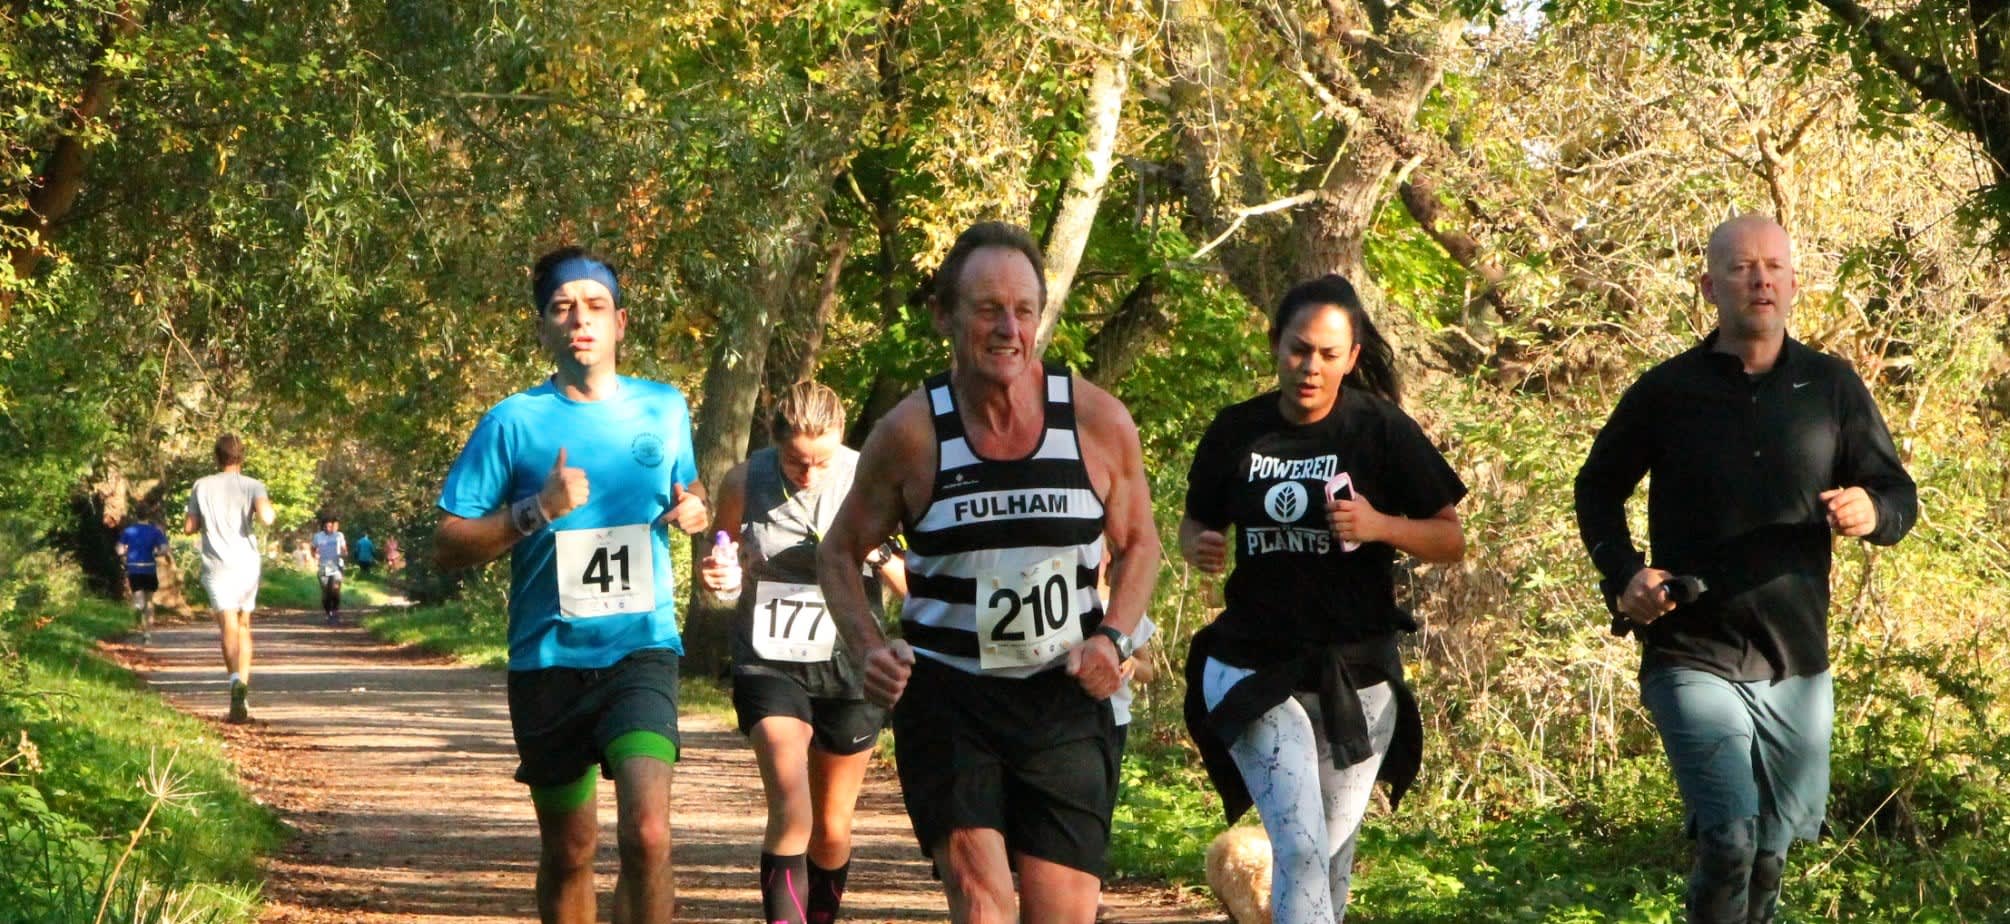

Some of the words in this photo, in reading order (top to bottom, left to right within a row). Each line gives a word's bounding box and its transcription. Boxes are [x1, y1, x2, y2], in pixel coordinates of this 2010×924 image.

[1248, 452, 1337, 482] POWERED
[954, 494, 1067, 521] FULHAM
[1247, 532, 1330, 555] PLANTS
[582, 545, 630, 592] 41
[765, 598, 825, 640] 177
[989, 574, 1068, 640] 210
